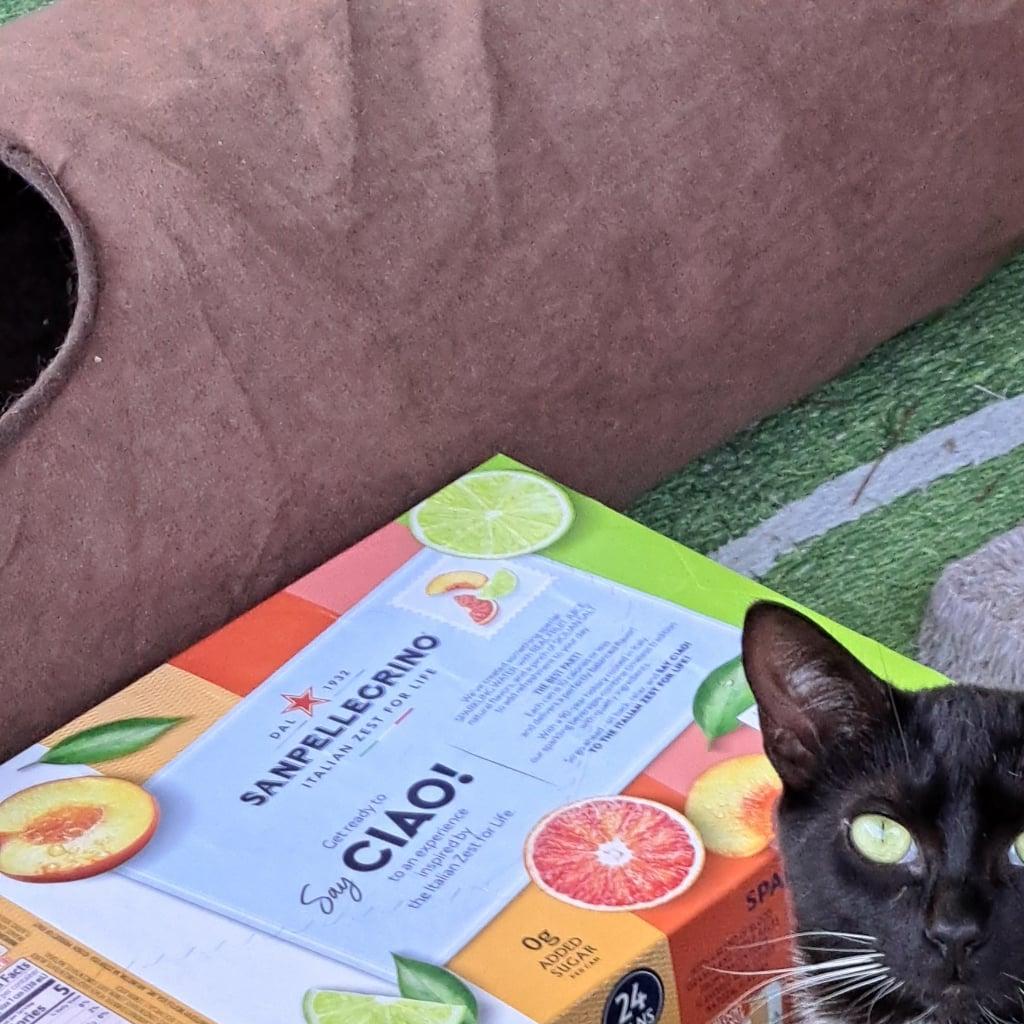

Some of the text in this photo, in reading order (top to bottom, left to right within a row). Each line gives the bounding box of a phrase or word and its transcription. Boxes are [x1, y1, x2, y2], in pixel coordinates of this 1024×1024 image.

[532, 651, 584, 695] THE BEST PART!
[655, 640, 694, 673] SAY CIAO!
[322, 669, 350, 690] 1932
[236, 633, 443, 807] SANPELLEGRINO
[587, 655, 693, 753] TO THE ITALIAN ZEST FOR LIFE!
[268, 718, 296, 739] DAL
[300, 667, 438, 788] ITALIAN ZEST FOR LIFE
[299, 762, 476, 915] Say CIAO!
[318, 792, 388, 849] Get ready to
[386, 807, 472, 882] to an experience
[415, 826, 476, 878] inspired by
[406, 891, 432, 909] the
[423, 862, 461, 891] Italian
[451, 841, 482, 862] Zest
[471, 825, 498, 842] for
[745, 872, 784, 912] SPA
[522, 929, 560, 951] 0g
[538, 936, 583, 970] ADDED
[550, 944, 598, 978] SUGAR
[0, 959, 31, 983] Facts
[52, 983, 71, 996] 5
